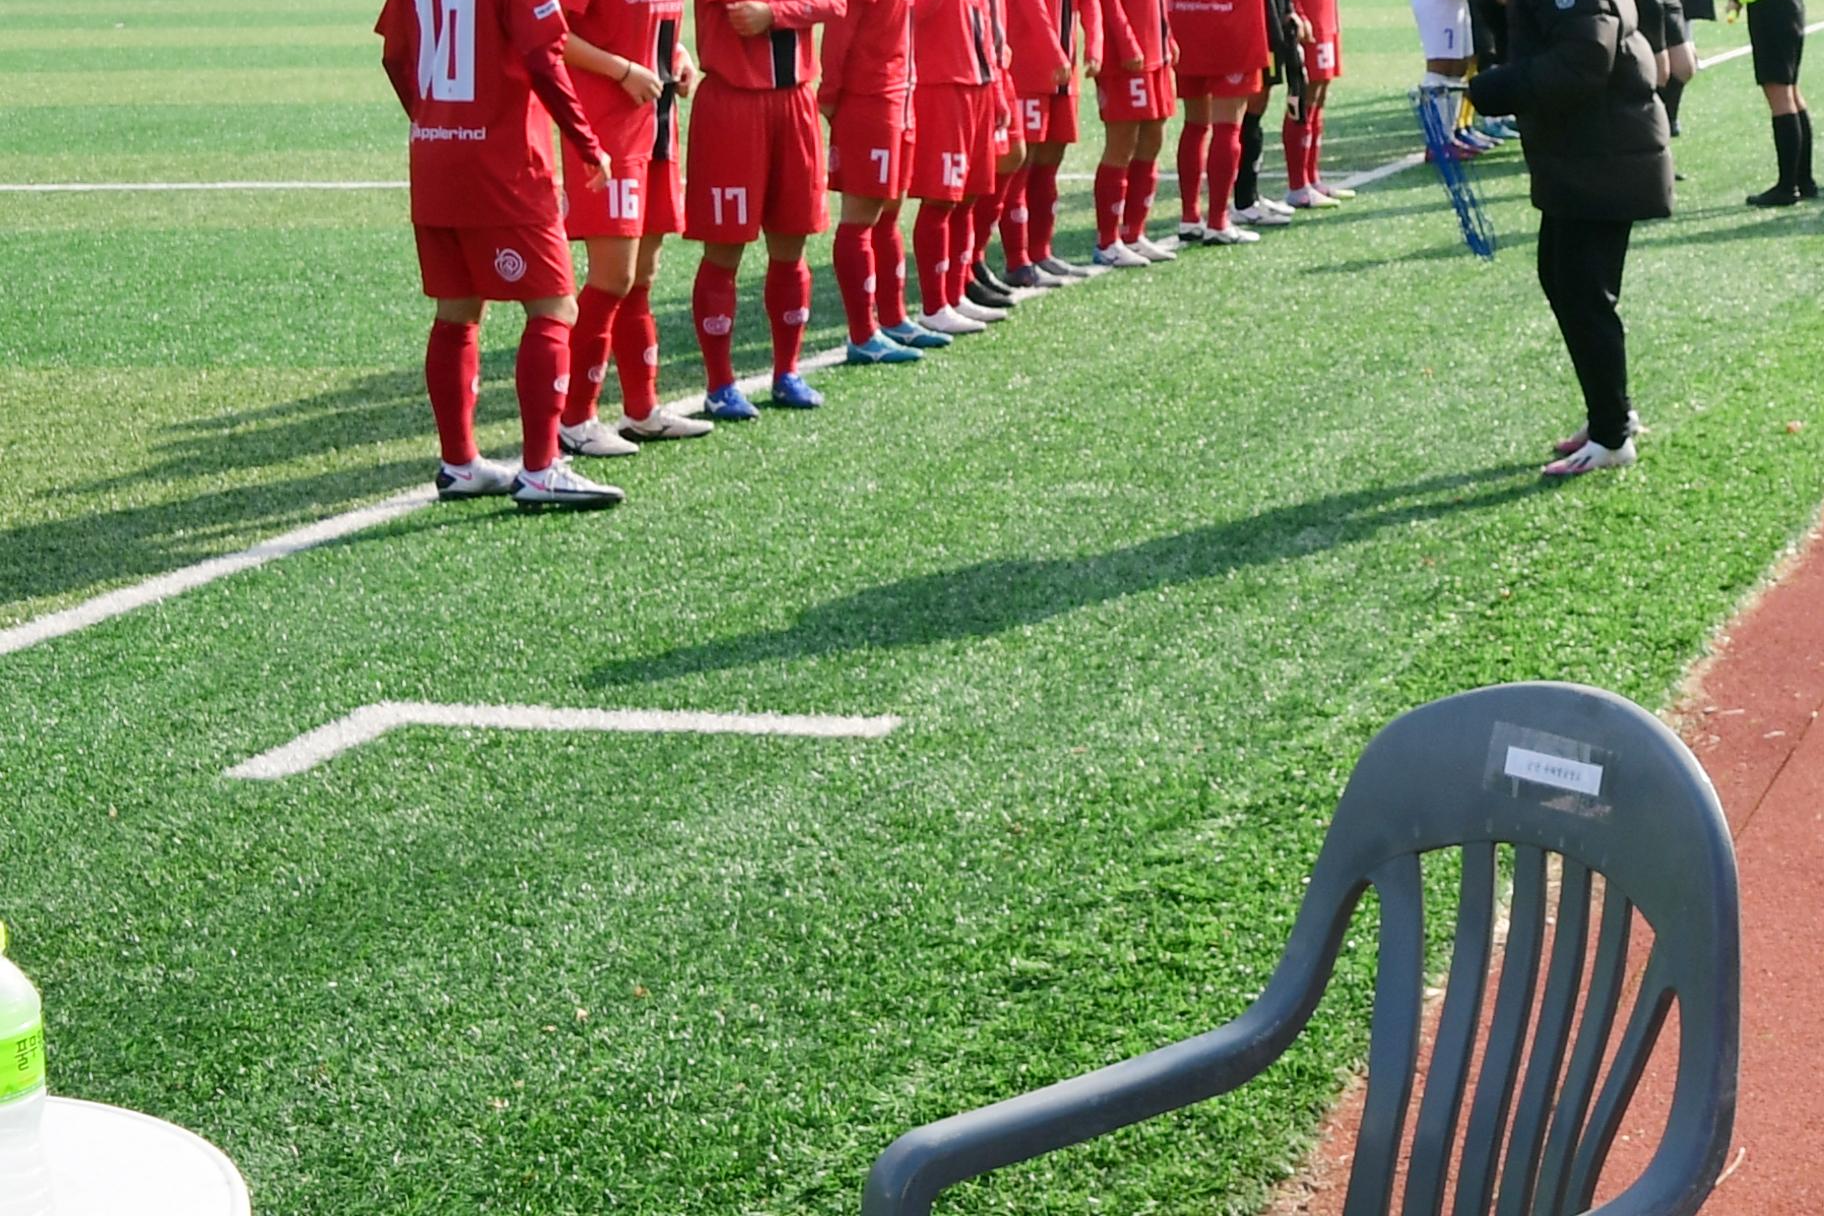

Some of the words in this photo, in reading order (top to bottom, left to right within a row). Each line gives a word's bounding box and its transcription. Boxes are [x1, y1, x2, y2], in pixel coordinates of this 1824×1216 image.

[1130, 78, 1147, 107] 5
[871, 149, 889, 183] 7
[607, 179, 638, 219] 16
[711, 187, 747, 225] 17
